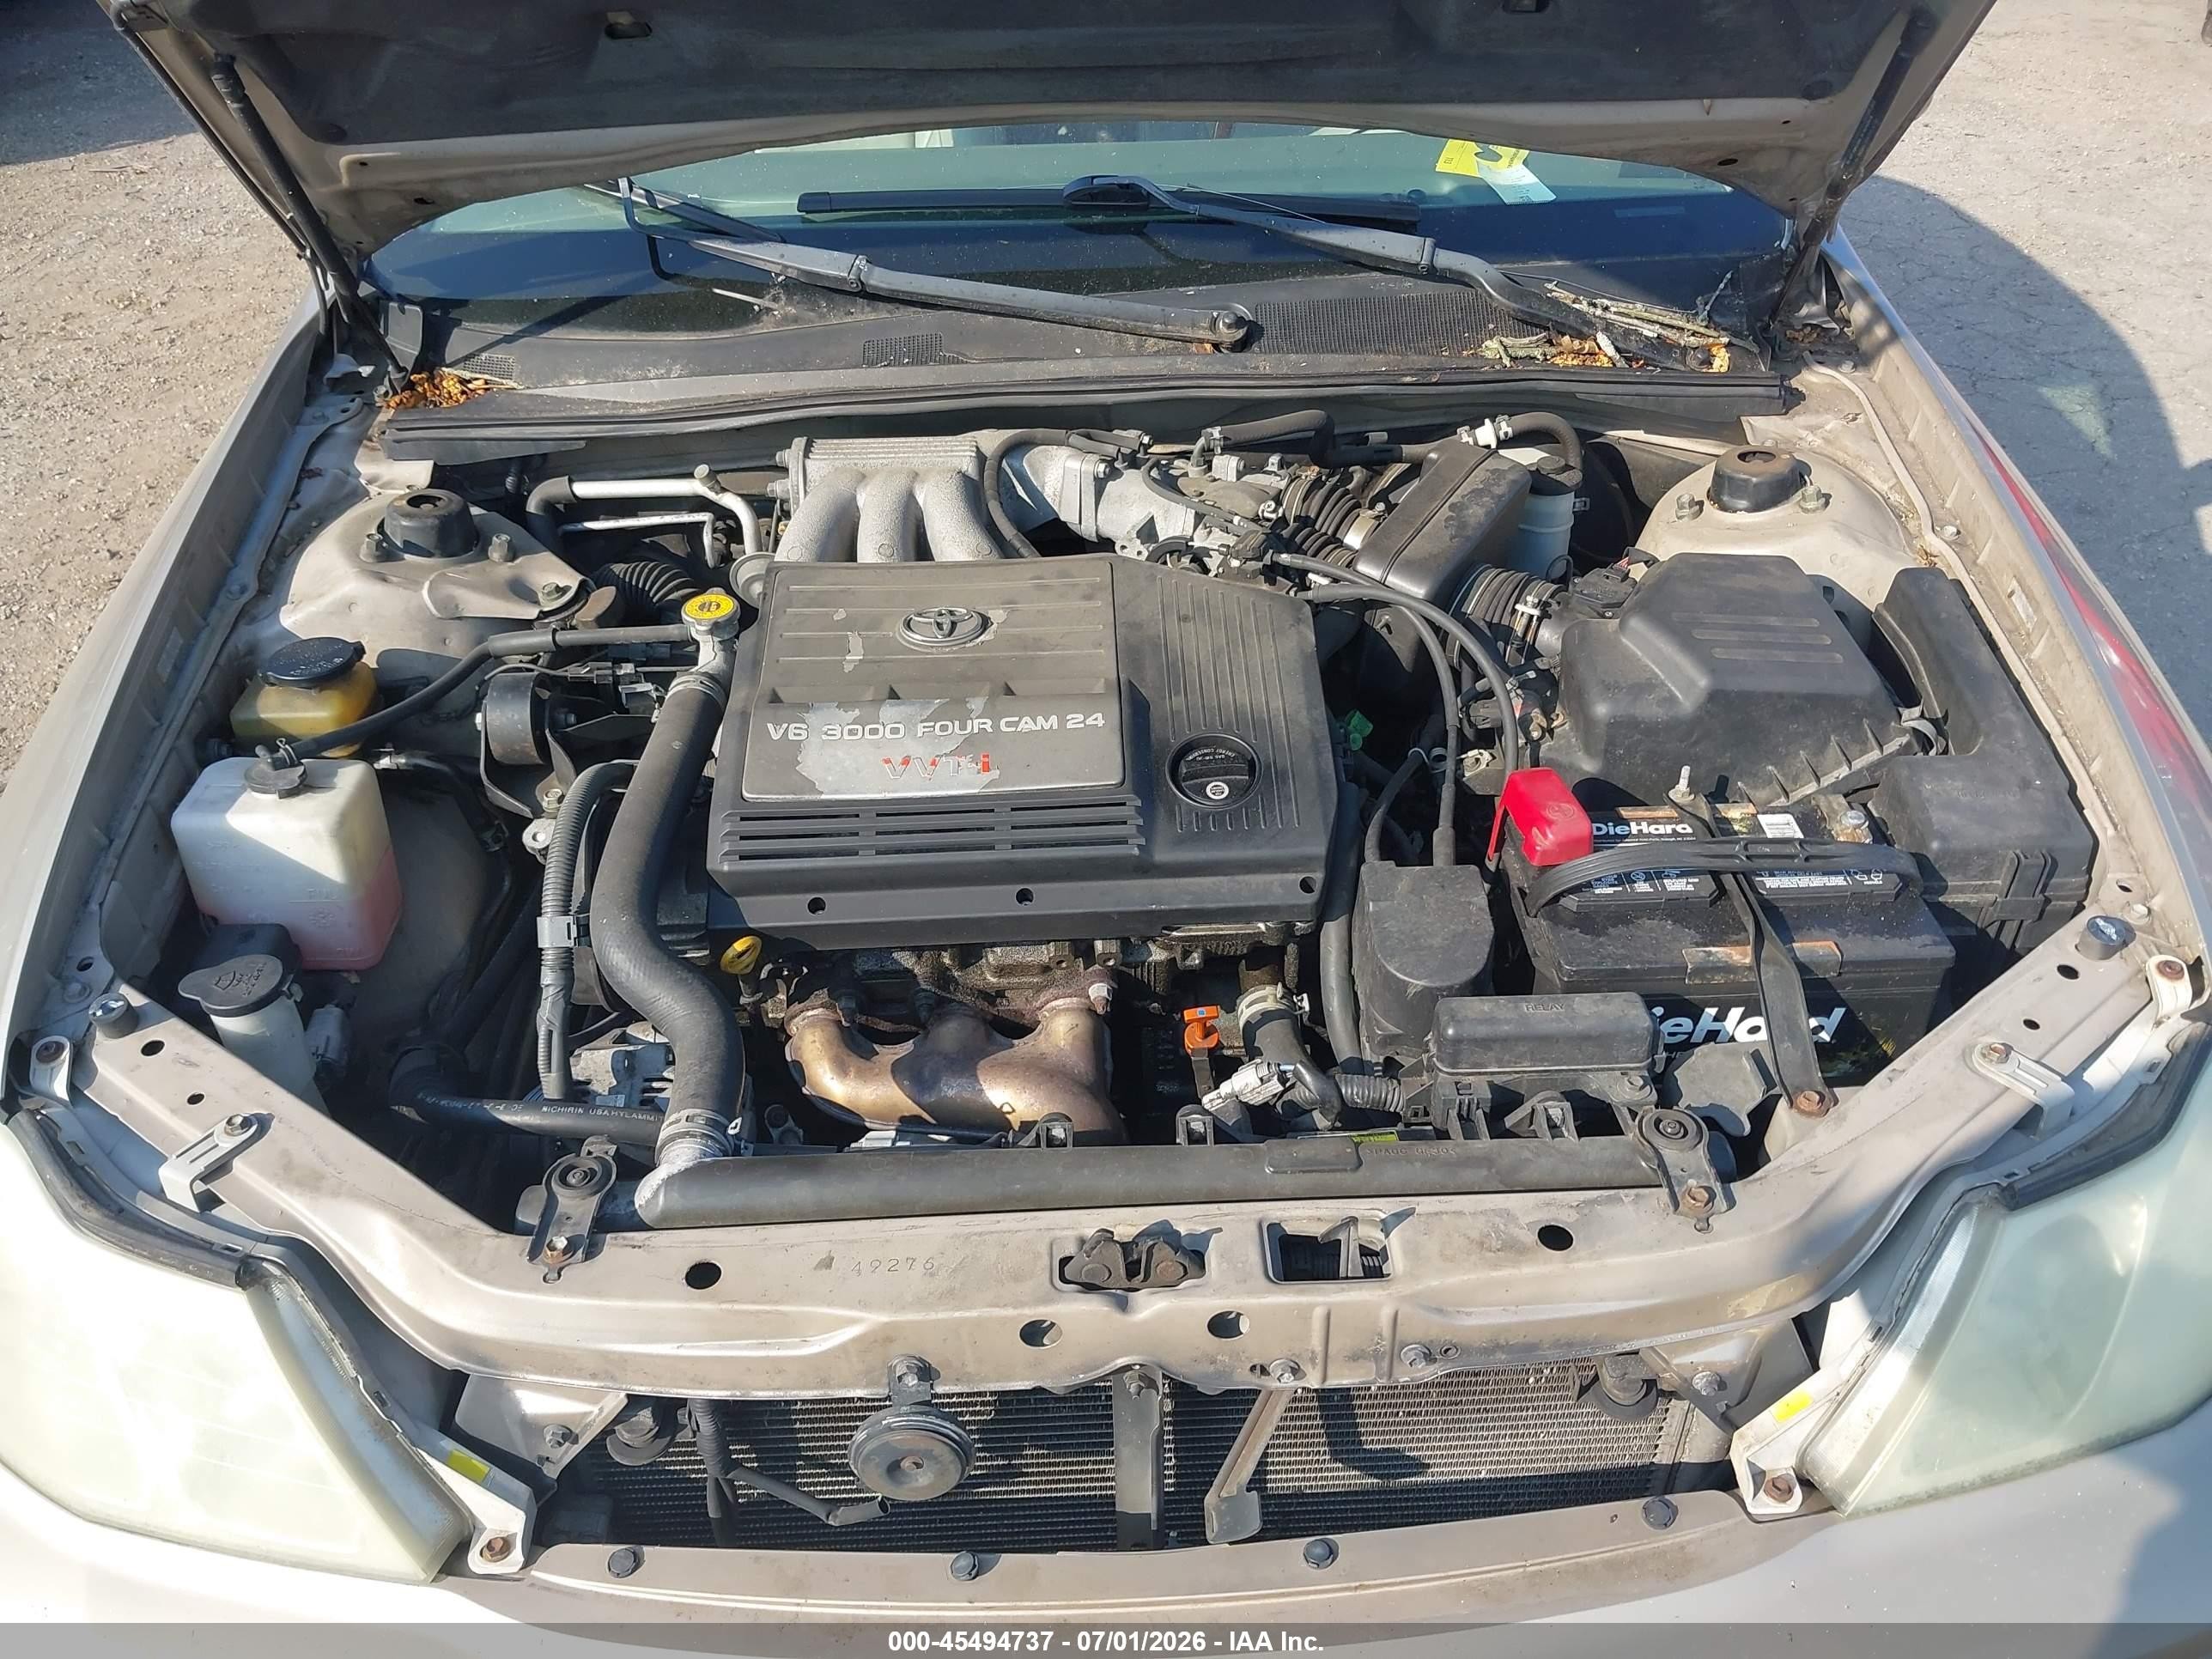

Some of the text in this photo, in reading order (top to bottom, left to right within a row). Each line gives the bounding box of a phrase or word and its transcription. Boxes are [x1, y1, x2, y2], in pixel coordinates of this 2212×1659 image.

[767, 712, 1105, 741] V6 3000 FOUR CAM 24
[1524, 1002, 1566, 1012] RELAY
